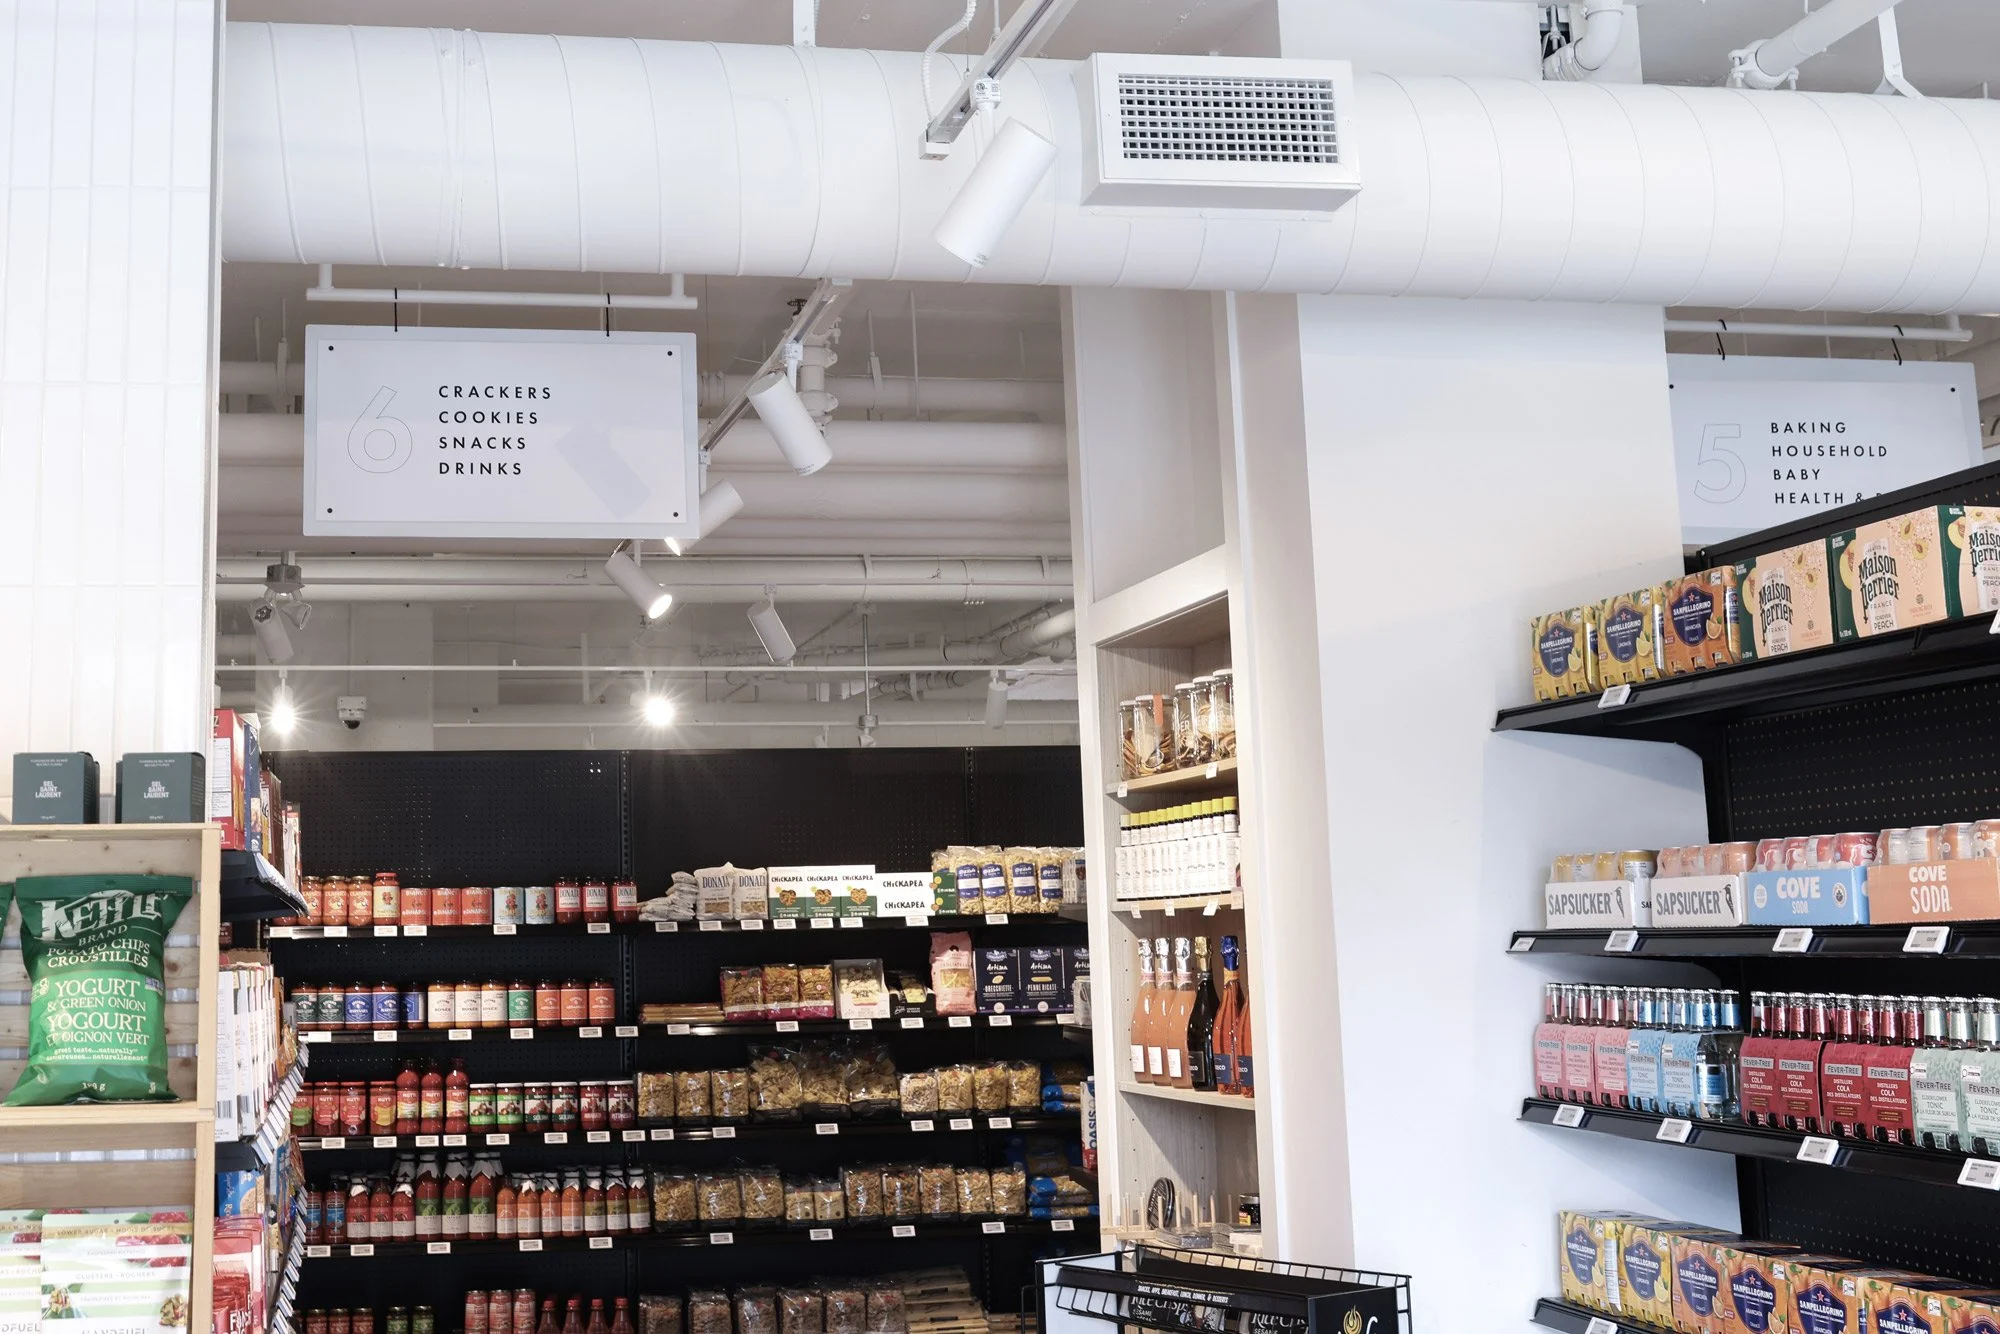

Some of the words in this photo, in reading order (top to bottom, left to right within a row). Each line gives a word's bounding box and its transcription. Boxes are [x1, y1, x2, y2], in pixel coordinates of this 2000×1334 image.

[438, 385, 552, 399] CRACKERS
[438, 410, 538, 425] COOKIES
[347, 384, 413, 474] 6
[1771, 421, 1847, 434] BAKING
[438, 436, 526, 450] SNACKS
[1772, 445, 1888, 458] HOUSEHOLD
[438, 461, 522, 476] DRINKS
[1693, 423, 1747, 504] 5
[1773, 468, 1821, 481] BABY
[1775, 492, 1844, 505] HEALTH
[1855, 492, 1864, 502] &
[1858, 551, 1898, 584] Maison
[1758, 580, 1793, 610] Maison
[1860, 572, 1900, 624] perrier
[1673, 601, 1711, 616] SANPELLEGRINO
[1870, 600, 1892, 609] FRANCE
[1607, 619, 1641, 633] SANPELLEGRINO
[1760, 601, 1794, 647] perrier
[1873, 620, 1894, 630] PEACH
[1540, 636, 1573, 650] SANPELLEGRINO
[1771, 644, 1788, 653] PEACH
[1908, 864, 1947, 883] COVE
[1776, 876, 1821, 899] COVE
[1548, 892, 1613, 916] SAPSUCKER
[1656, 890, 1722, 916] SAPSUCKER
[1791, 900, 1809, 914] SODA
[1910, 885, 1950, 915] SODA
[78, 924, 128, 947] BRAND
[110, 938, 150, 955] CHIPS
[47, 950, 148, 968] CROUSTILLES
[1030, 962, 1052, 971] Artisan
[987, 963, 1008, 971] Artisan
[55, 977, 140, 998] YOGURT
[47, 1001, 57, 1013] &
[60, 996, 105, 1011] GREEN
[108, 997, 147, 1012] ONION
[47, 1012, 146, 1033] YOGOURT
[61, 1031, 113, 1043] OIGNON
[116, 1031, 150, 1046] VERT
[1743, 1058, 1771, 1067] FEVER-TREE
[1781, 1061, 1811, 1071] FEVER-TREE
[1827, 1065, 1860, 1075] FEVER-TREE
[1751, 1076, 1764, 1084] COLA
[1870, 1068, 1905, 1079] FEVER-TREE
[1790, 1080, 1803, 1088] COLA
[1916, 1080, 1952, 1091] FEVER-TREE
[1880, 1089, 1896, 1097] COLA
[1926, 1101, 1944, 1110] TONIC
[1980, 1106, 1998, 1115] TONIC
[1567, 1241, 1596, 1256] SANPELLEGRINO
[1625, 1254, 1659, 1270] SANPELLEGRINO
[1679, 1268, 1717, 1284] SANPELLEGRINO
[1732, 1283, 1774, 1300] SANPELLEGRINO
[1799, 1299, 1844, 1317] SANPELLEGRINO
[1879, 1319, 1929, 1334] SANPELLEGRINO
